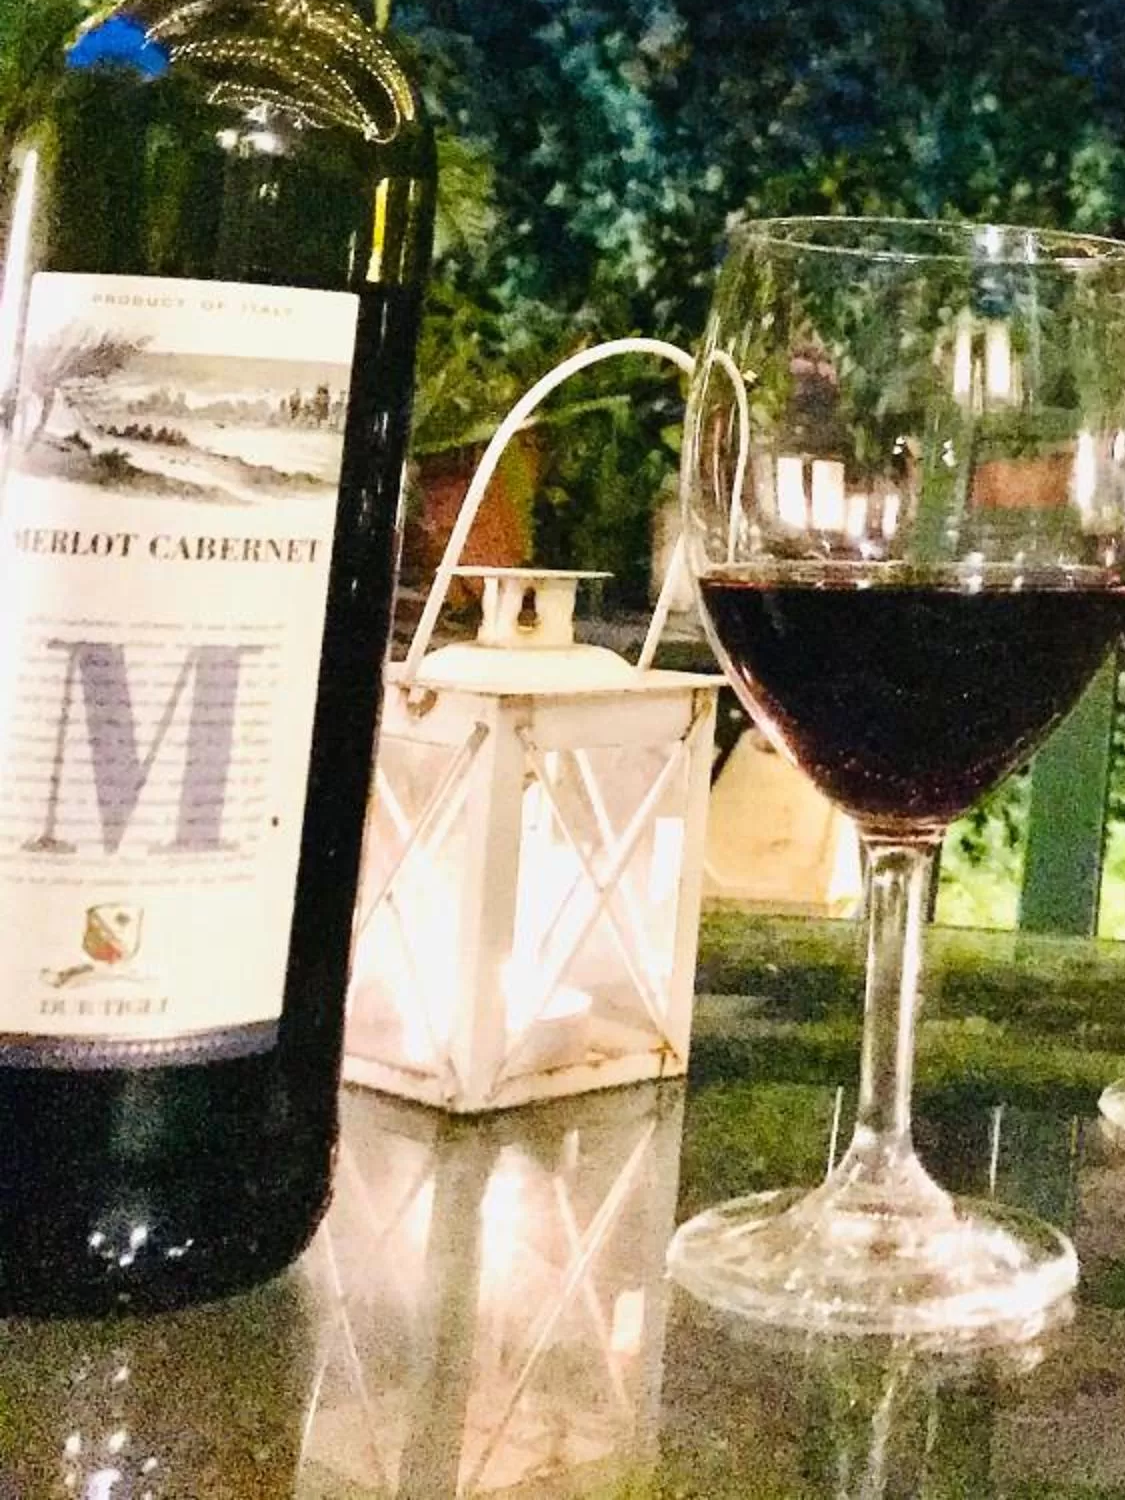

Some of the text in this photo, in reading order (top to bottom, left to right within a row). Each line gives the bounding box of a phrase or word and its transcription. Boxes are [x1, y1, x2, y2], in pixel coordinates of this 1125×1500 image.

[91, 292, 295, 317] PRODUCT OF ITALY
[147, 532, 323, 564] CABERNET
[20, 638, 265, 856] M
